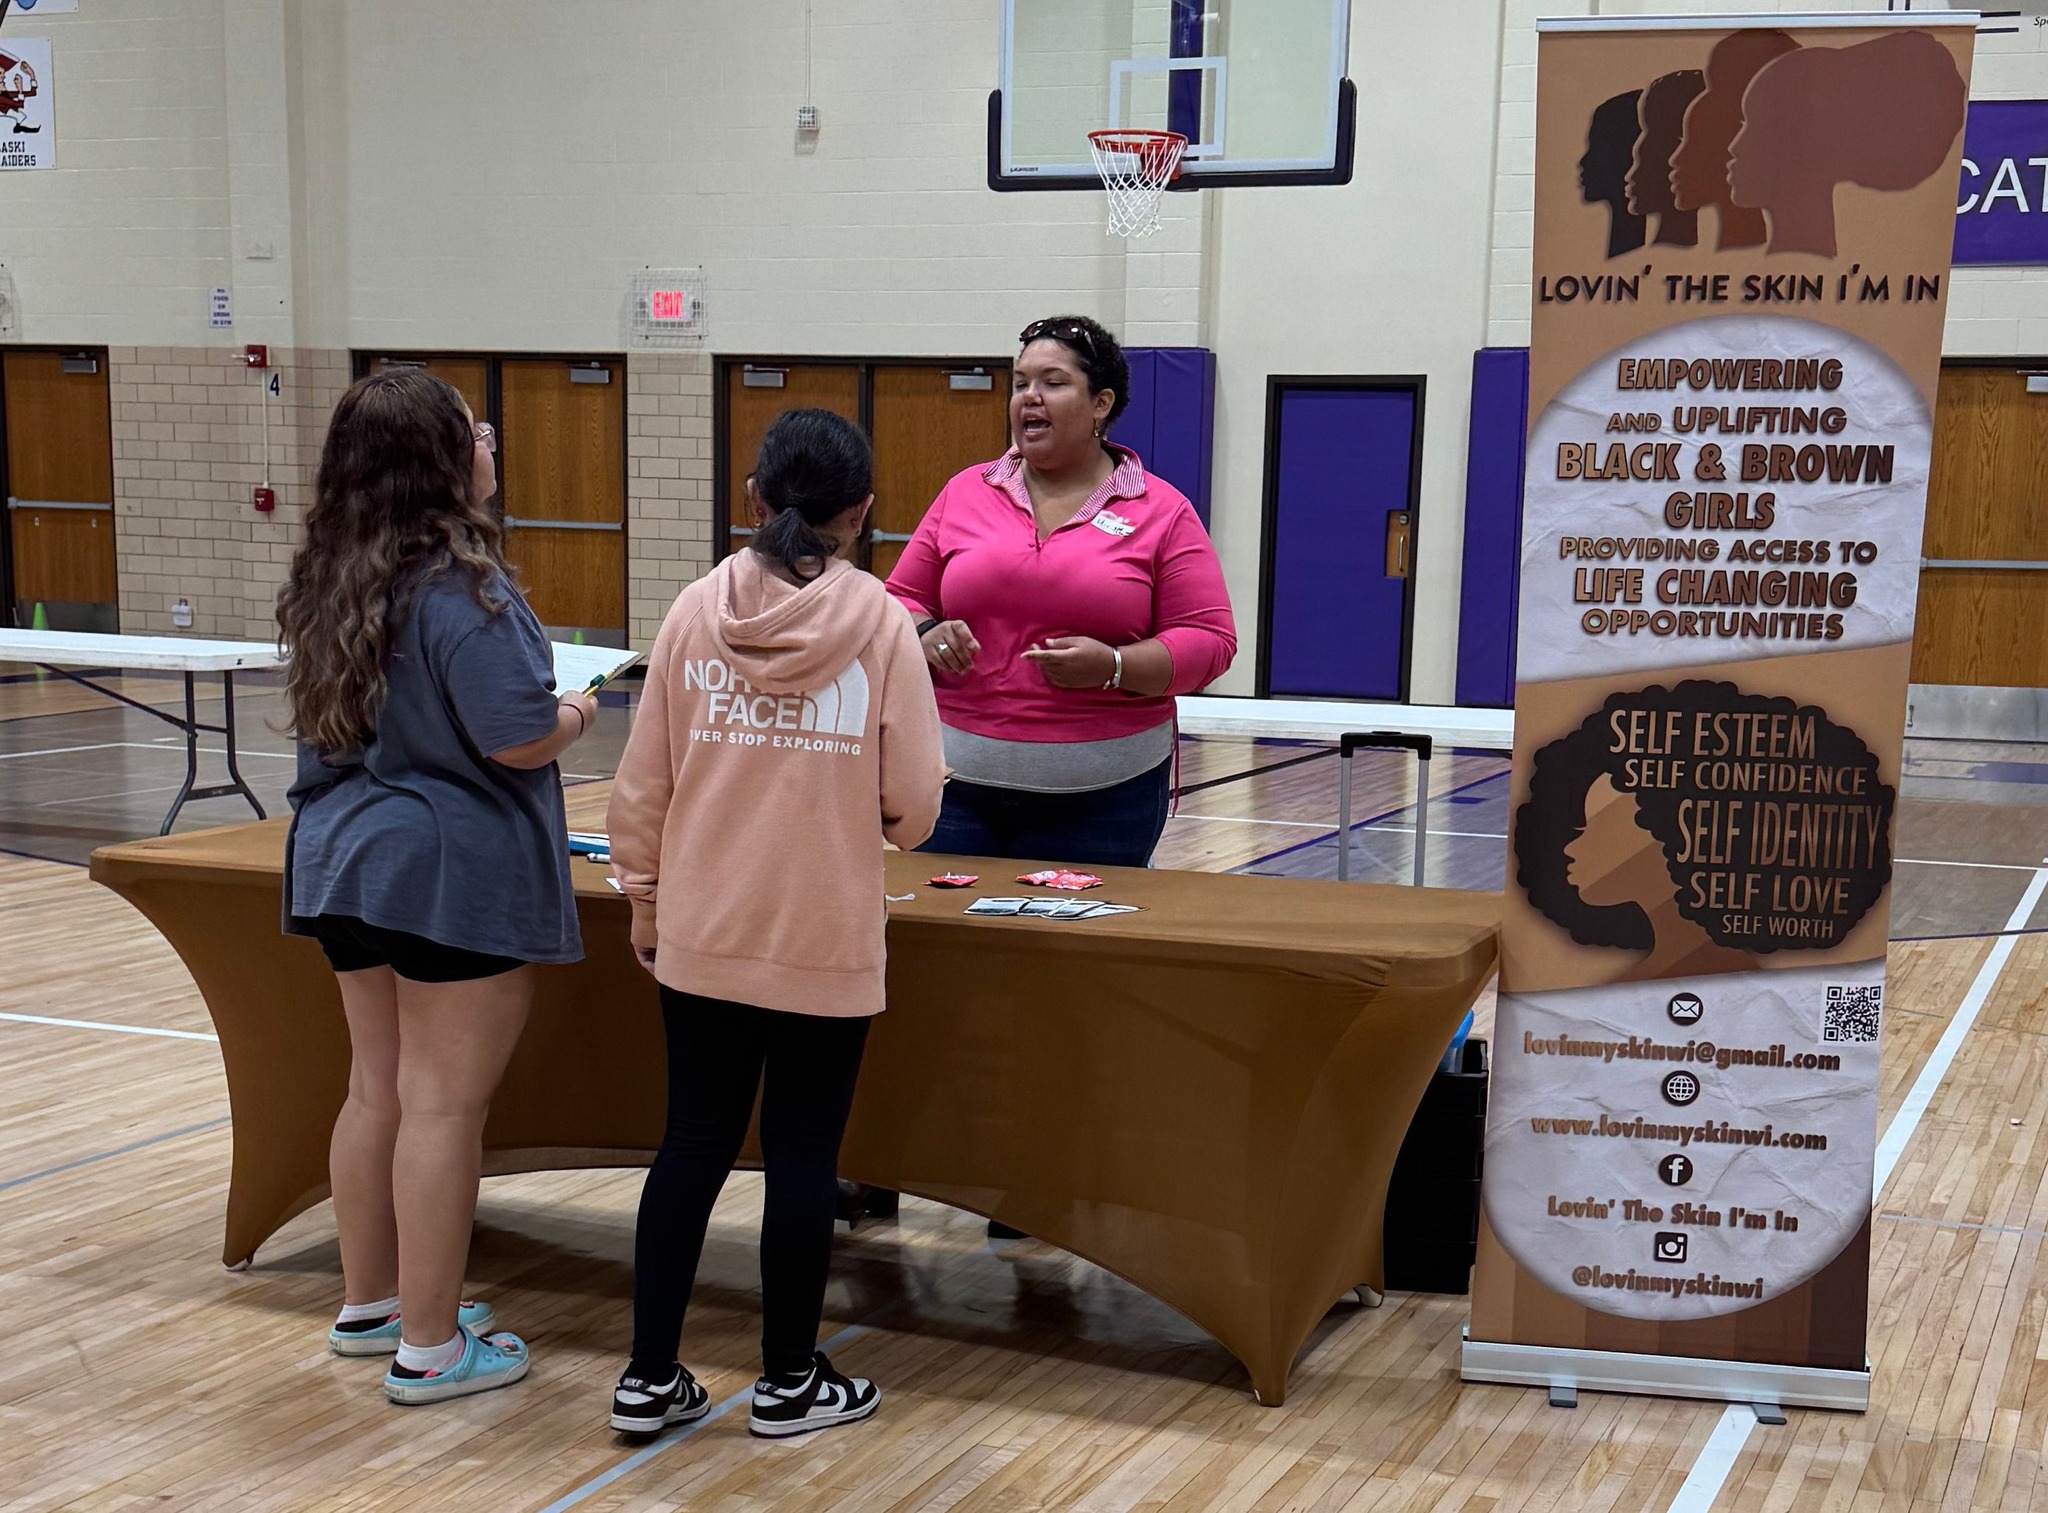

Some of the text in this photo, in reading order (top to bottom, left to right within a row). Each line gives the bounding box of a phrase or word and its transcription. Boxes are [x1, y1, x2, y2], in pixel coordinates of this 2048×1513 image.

[2034, 16, 2048, 28] Sp
[0, 141, 25, 153] ASKI
[1540, 264, 1941, 303] LOVIN' THE SKIN I'M IN
[653, 290, 684, 319] EXIT
[269, 373, 280, 397] 4
[1618, 358, 1843, 391] EMPOWERING
[1607, 406, 1847, 434] AND UPLIFTING
[1557, 442, 1895, 483] BLACK & BROWN
[1664, 491, 1776, 530] GIRLS
[1559, 536, 1878, 564] PROVIDING ACCESS TO
[1573, 568, 1857, 609] LIFE CHANGING
[1581, 608, 1845, 640] OPPORTUNITIES
[684, 659, 751, 693] NOR
[708, 692, 800, 730] FACE
[728, 731, 767, 746] STOP
[772, 735, 861, 756] EXPLORING
[1609, 709, 1816, 760] SELF ESTEEM
[1623, 758, 1867, 796] SELF CONFIDENCE
[1676, 798, 1884, 870] SELF IDENTITY
[1689, 871, 1851, 915] SELF LOVE
[1722, 914, 1834, 939] SELF WORTH
[1524, 1030, 1841, 1071] lovinmyskinwi@gmail.com
[1531, 1114, 1828, 1151] www.lovinmyskinwi.com
[1547, 1195, 1799, 1233] Lovin' The Skin I'm In
[1571, 1264, 1765, 1299] @lovinmyskinwi
